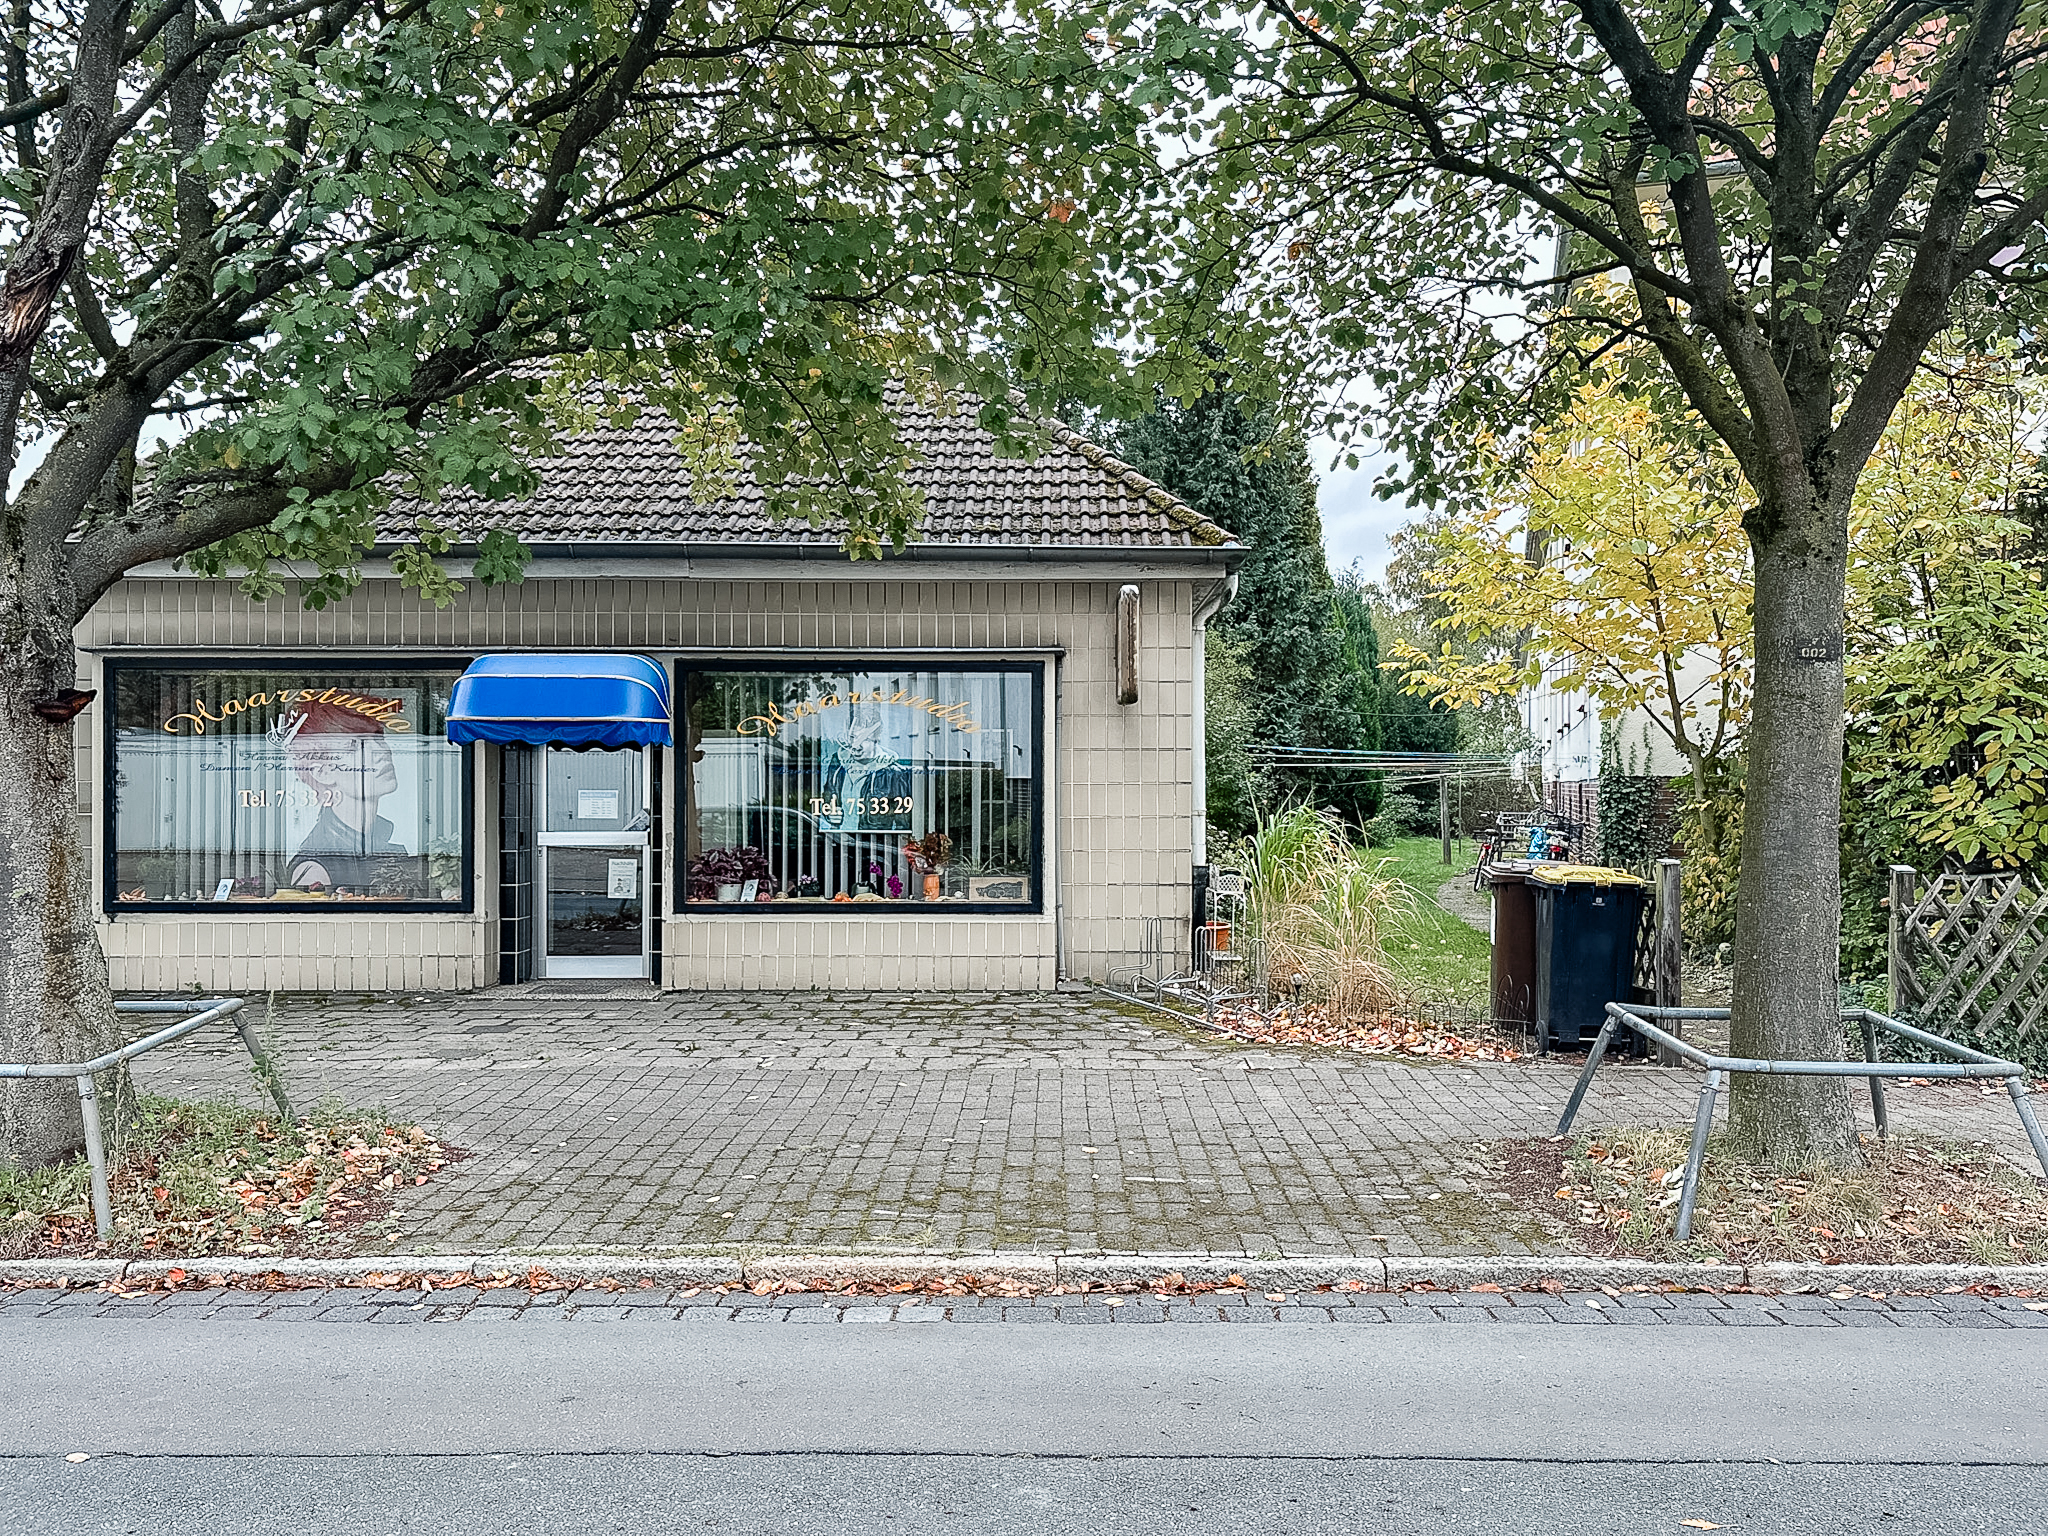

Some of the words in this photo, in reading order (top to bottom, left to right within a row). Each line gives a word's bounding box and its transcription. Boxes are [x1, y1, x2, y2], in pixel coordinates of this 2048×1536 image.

[1801, 647, 1827, 658] 002
[163, 686, 413, 735] Haarstudio
[736, 687, 982, 737] Haarstudio
[237, 789, 271, 808] Tel.
[275, 789, 296, 808] 75
[300, 790, 319, 808] 33
[323, 790, 343, 808] 29
[809, 798, 843, 816] Tel.
[846, 798, 866, 815] 75
[869, 797, 890, 815] 33
[893, 796, 914, 814] 29
